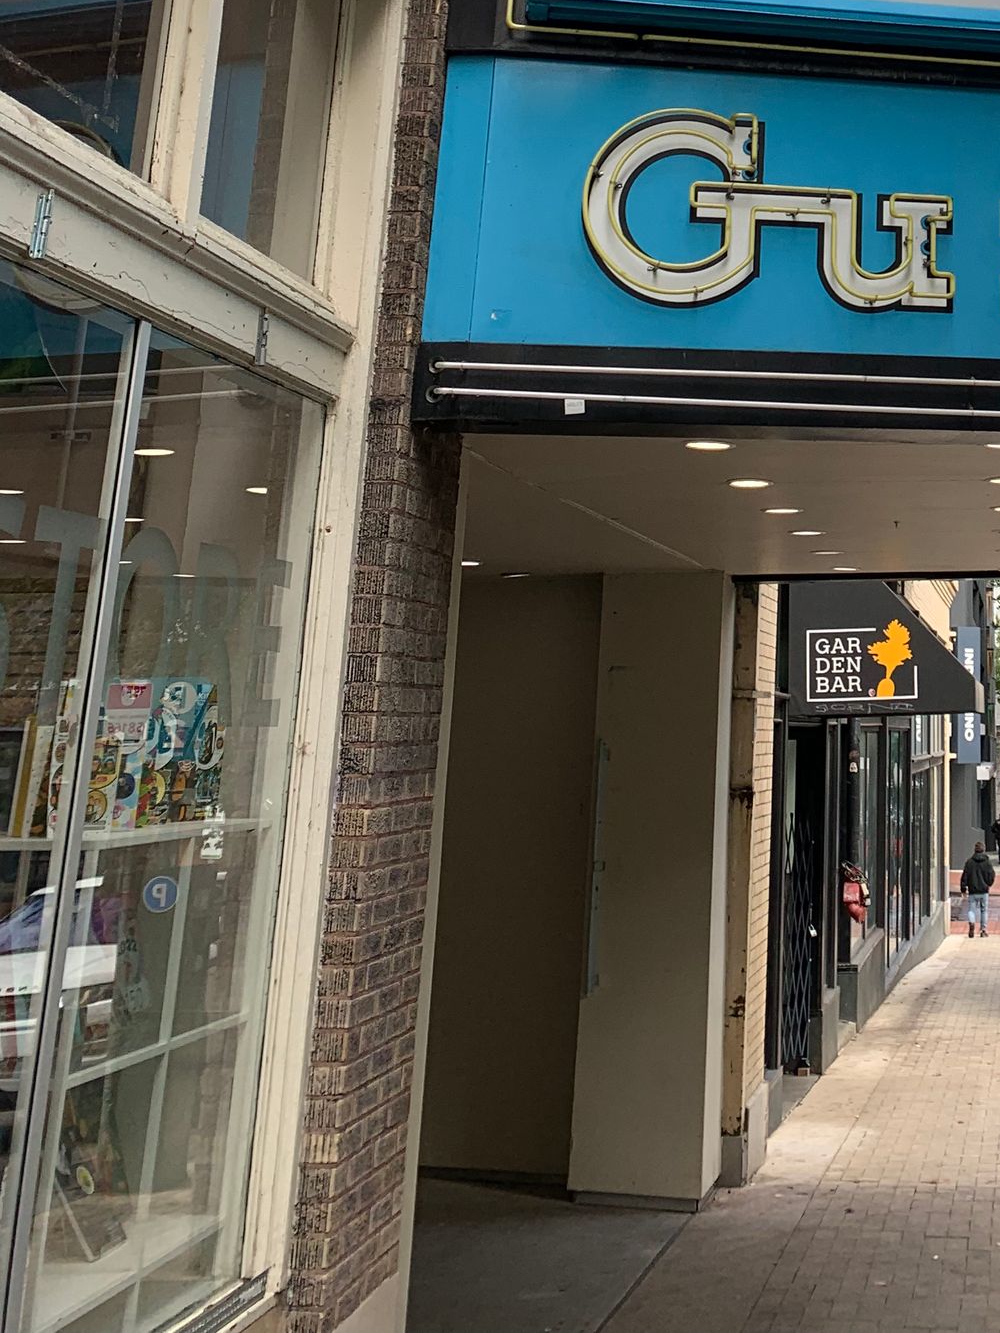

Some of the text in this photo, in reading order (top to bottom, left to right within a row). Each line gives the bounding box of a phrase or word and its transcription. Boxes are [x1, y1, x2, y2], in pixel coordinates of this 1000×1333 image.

[815, 637, 862, 655] GAR
[815, 656, 862, 674] DEN
[815, 676, 862, 693] BAR
